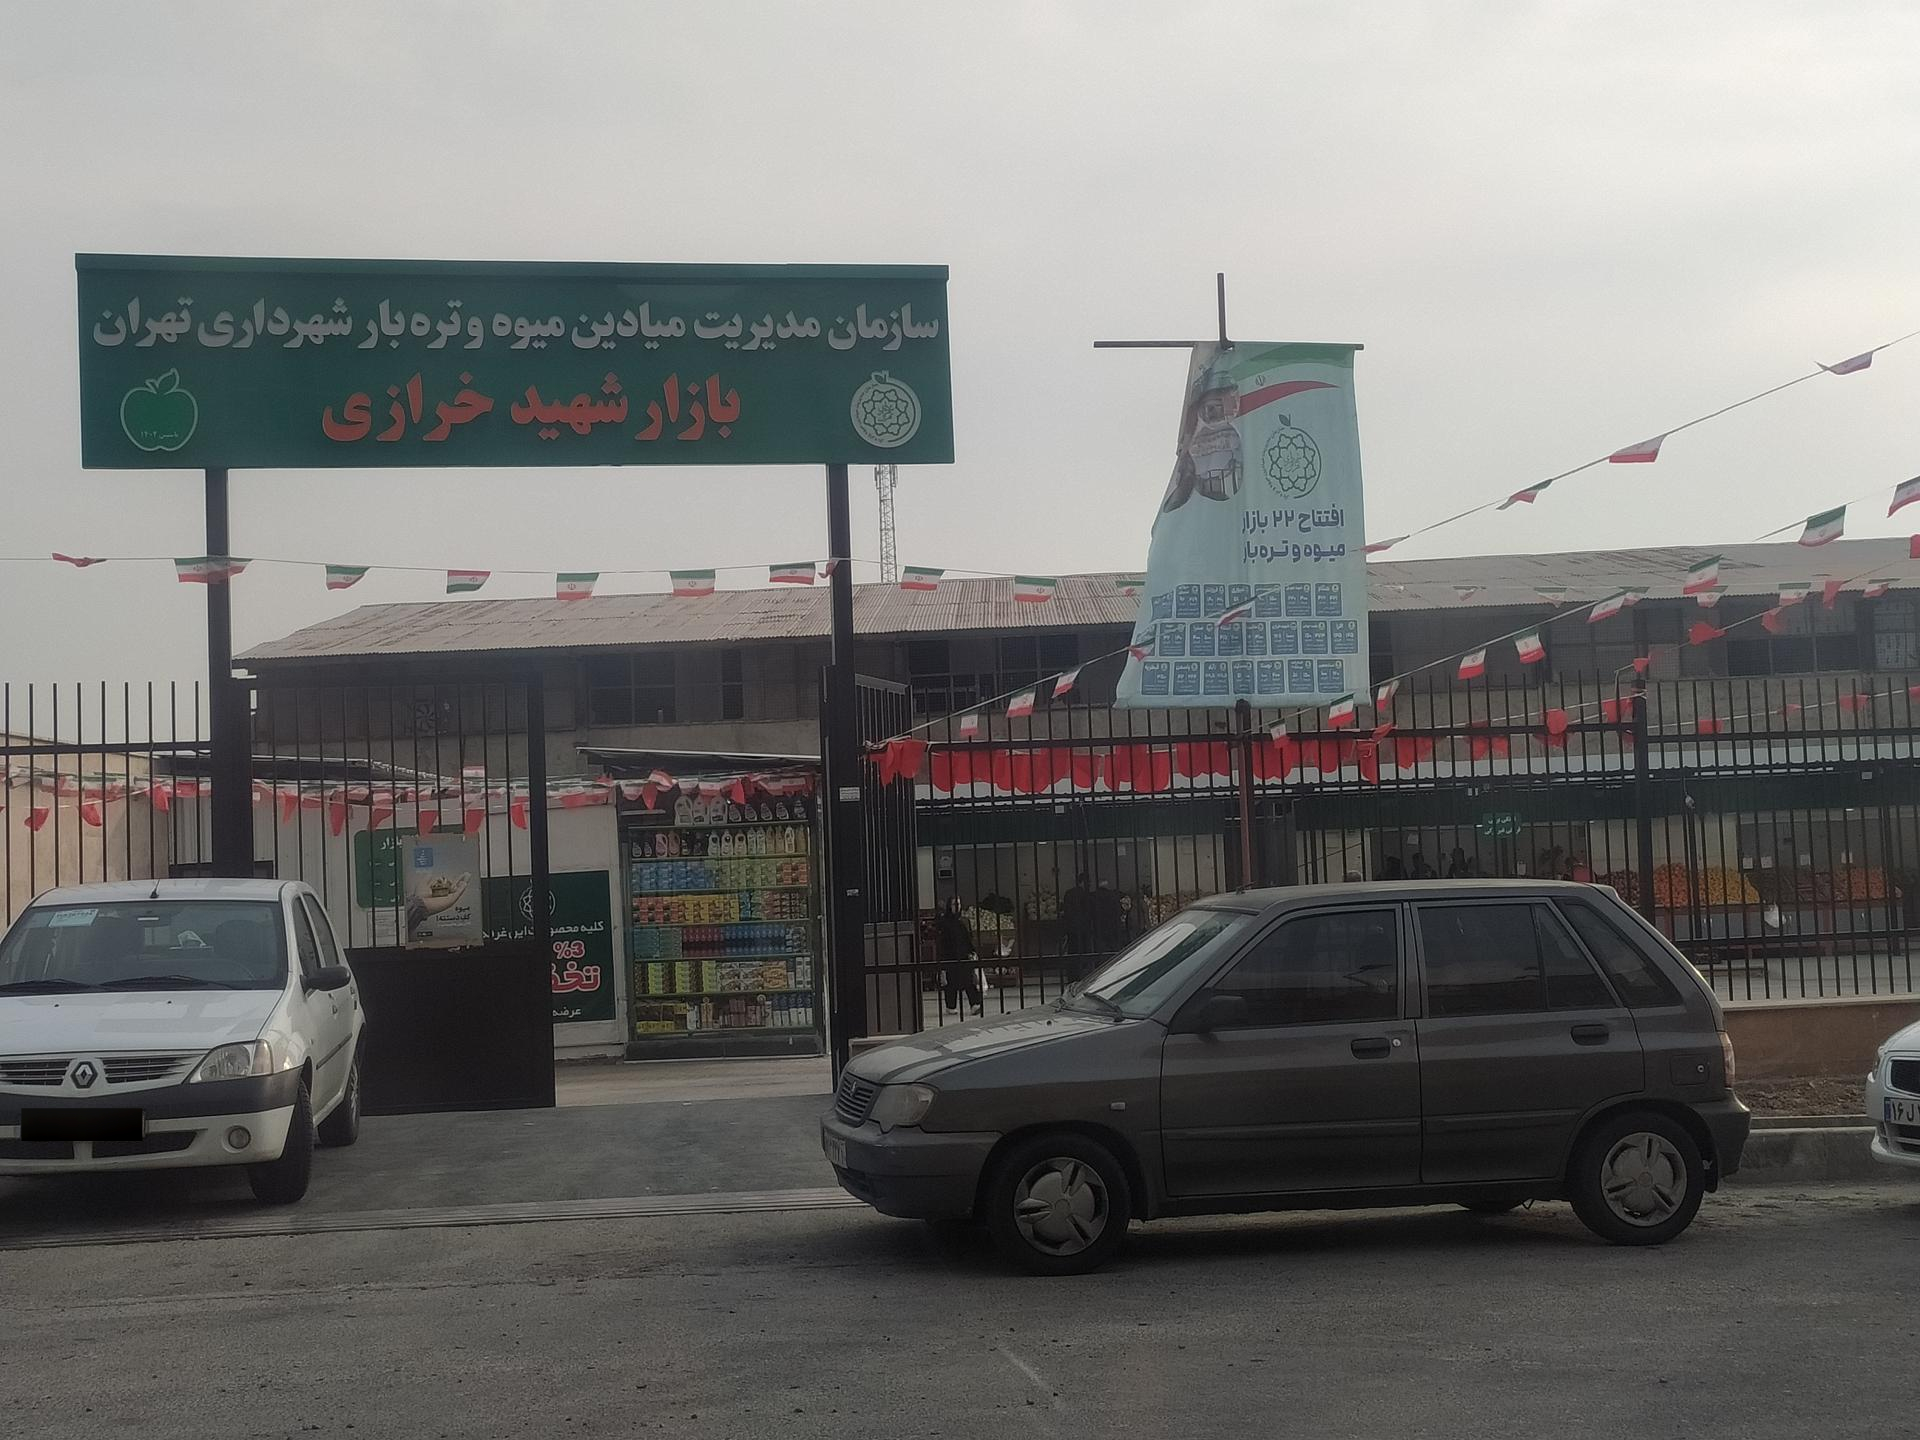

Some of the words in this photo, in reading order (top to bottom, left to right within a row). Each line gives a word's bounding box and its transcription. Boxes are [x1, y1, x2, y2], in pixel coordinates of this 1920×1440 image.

[93, 296, 194, 347] تهران
[198, 297, 353, 348] شهرداری
[493, 313, 565, 349] میوه
[572, 301, 687, 350] میادین
[694, 310, 821, 350] مدیریت
[828, 302, 939, 350] سازمان
[322, 371, 495, 442] خرازی
[510, 371, 629, 440] شهید
[635, 372, 741, 441] بازار
[1242, 509, 1268, 535] بازار
[1272, 509, 1294, 528] ۲۲
[1298, 503, 1345, 533] افتتاح
[1303, 543, 1346, 562] میوه
[580, 920, 605, 935] کلیه
[552, 1005, 582, 1018] عرضه
